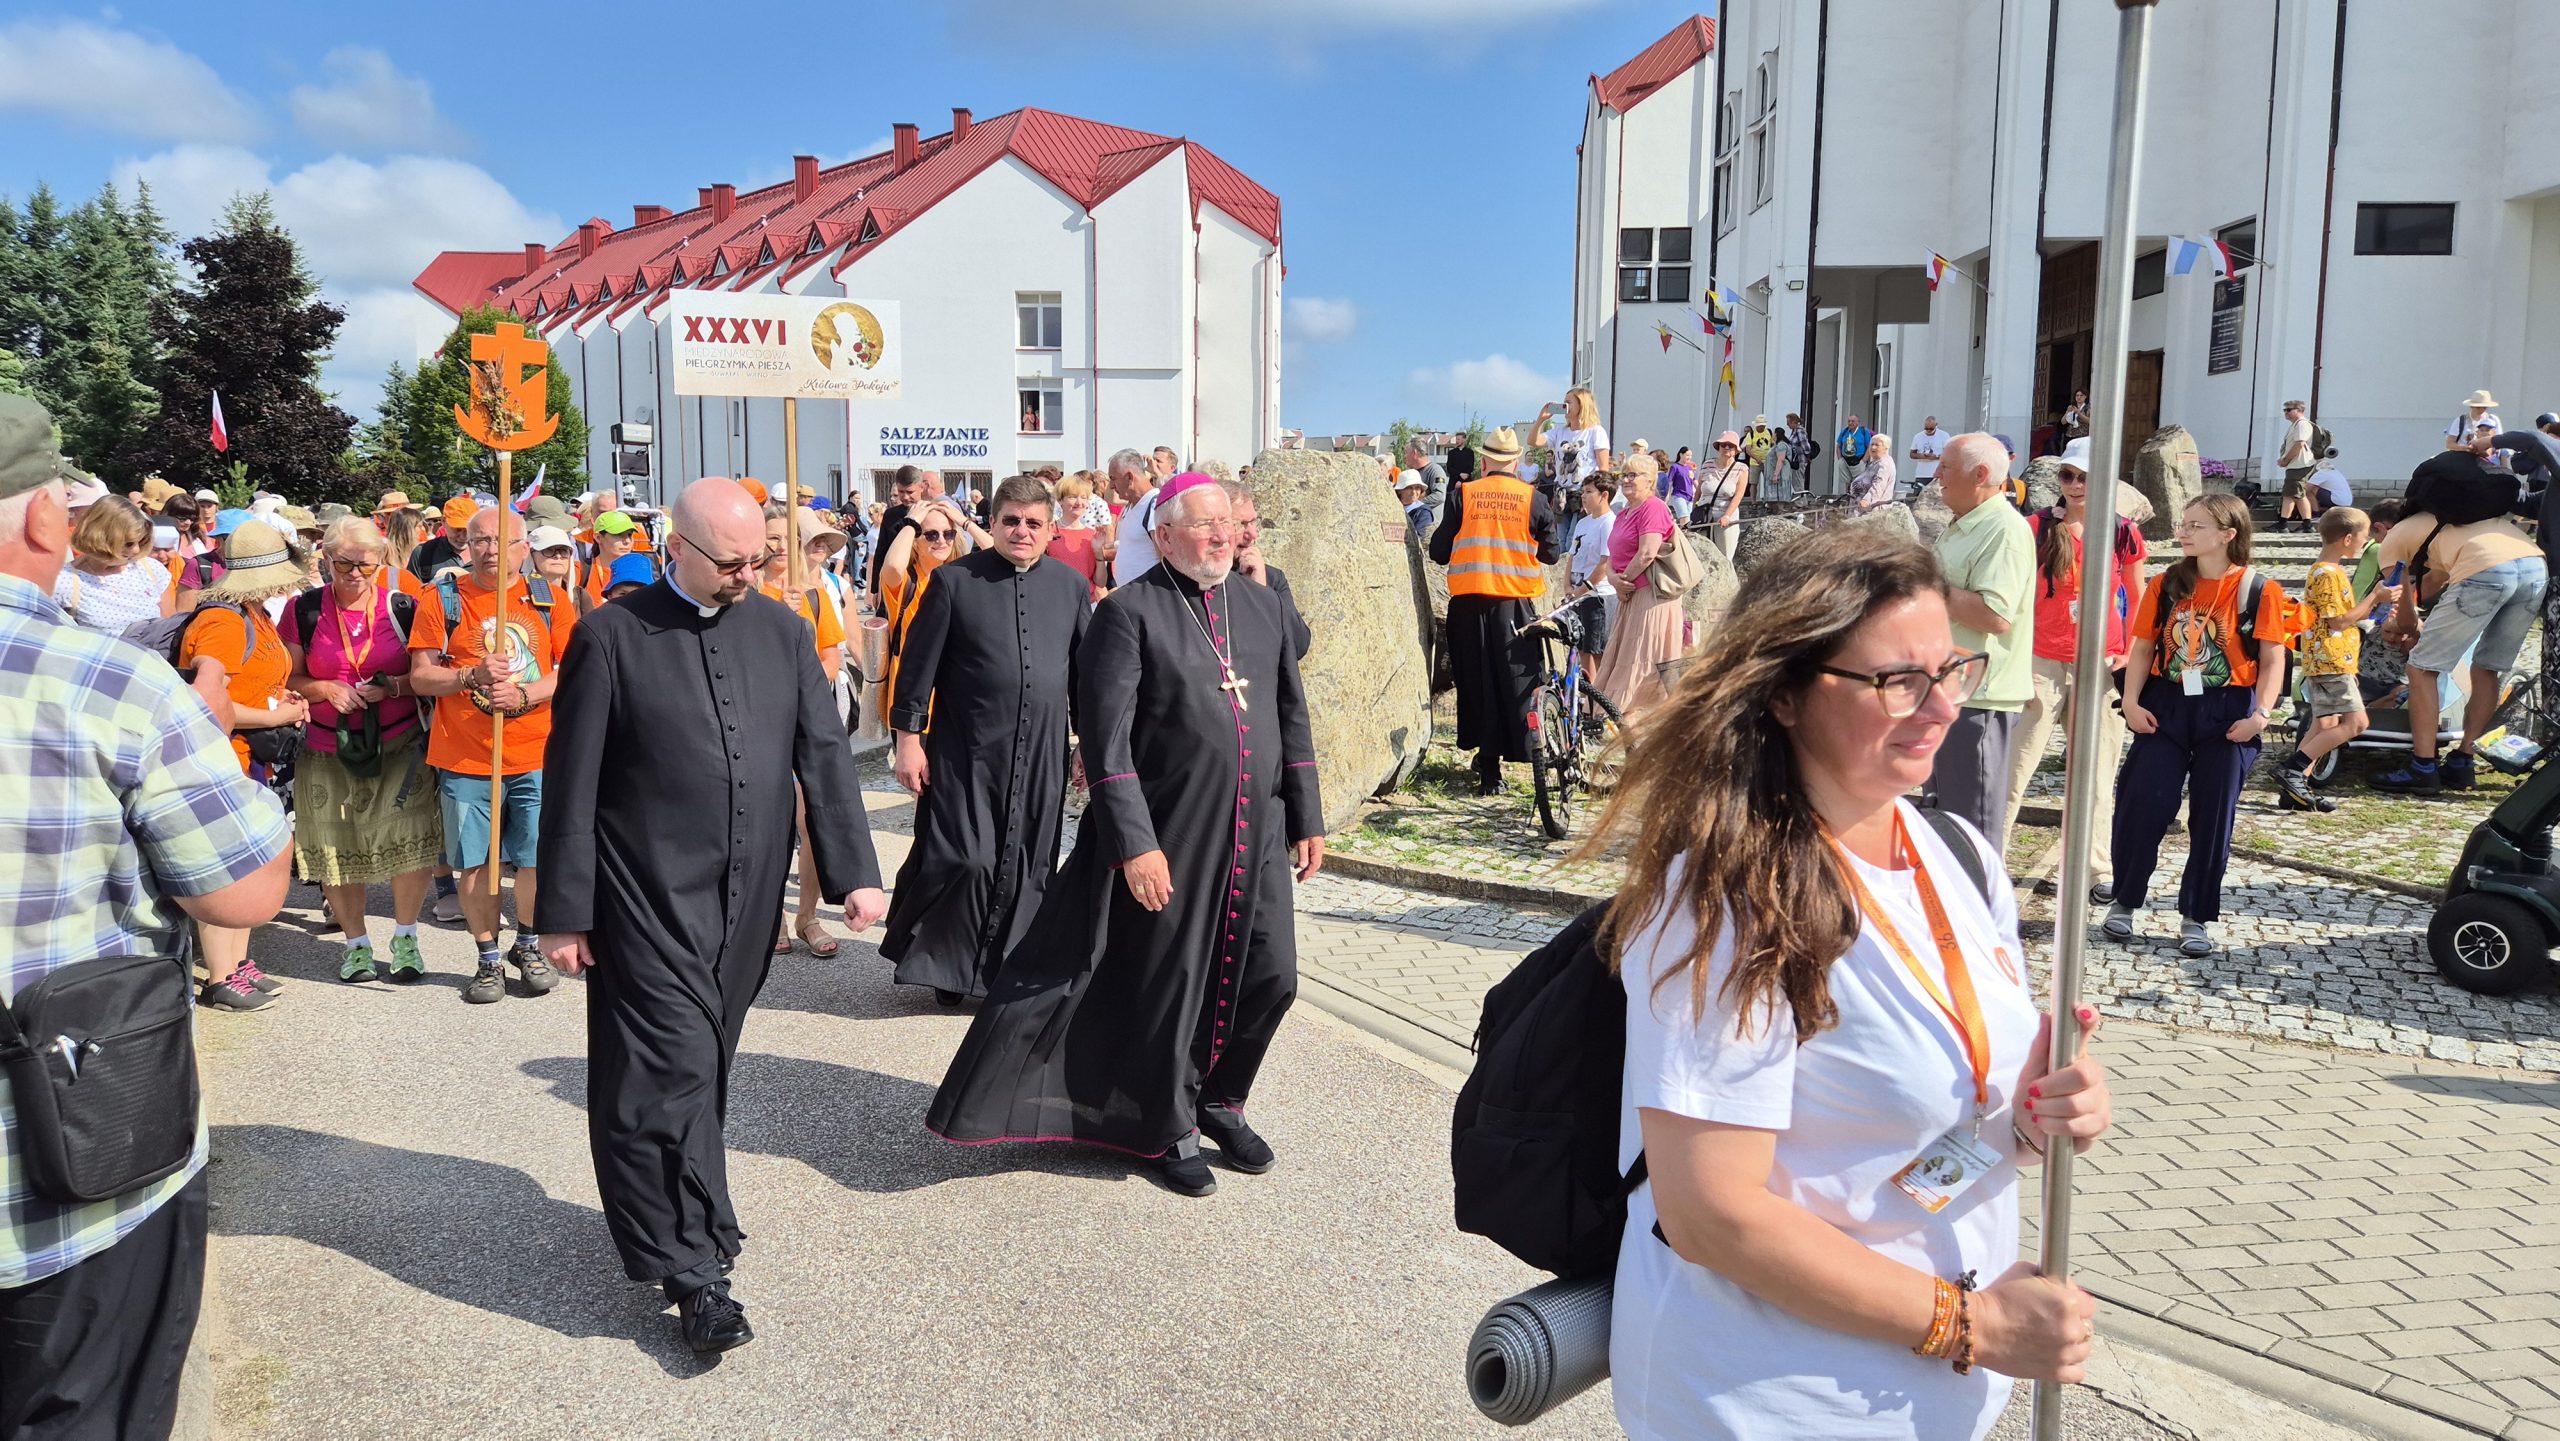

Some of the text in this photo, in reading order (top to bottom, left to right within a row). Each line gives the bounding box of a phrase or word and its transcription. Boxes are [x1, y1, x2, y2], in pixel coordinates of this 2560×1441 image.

[683, 316, 787, 345] XXXVI
[685, 358, 791, 371] PIELGRZYMKA PIESZA
[803, 378, 890, 394] Królowa Pokoju
[880, 427, 989, 440] SALEZJANIE
[880, 443, 988, 459] KSIĘDZA BOSKO
[1471, 491, 1524, 502] KIEROWANIE
[1477, 501, 1517, 511] RUCHEM
[1936, 931, 1957, 953] 36
